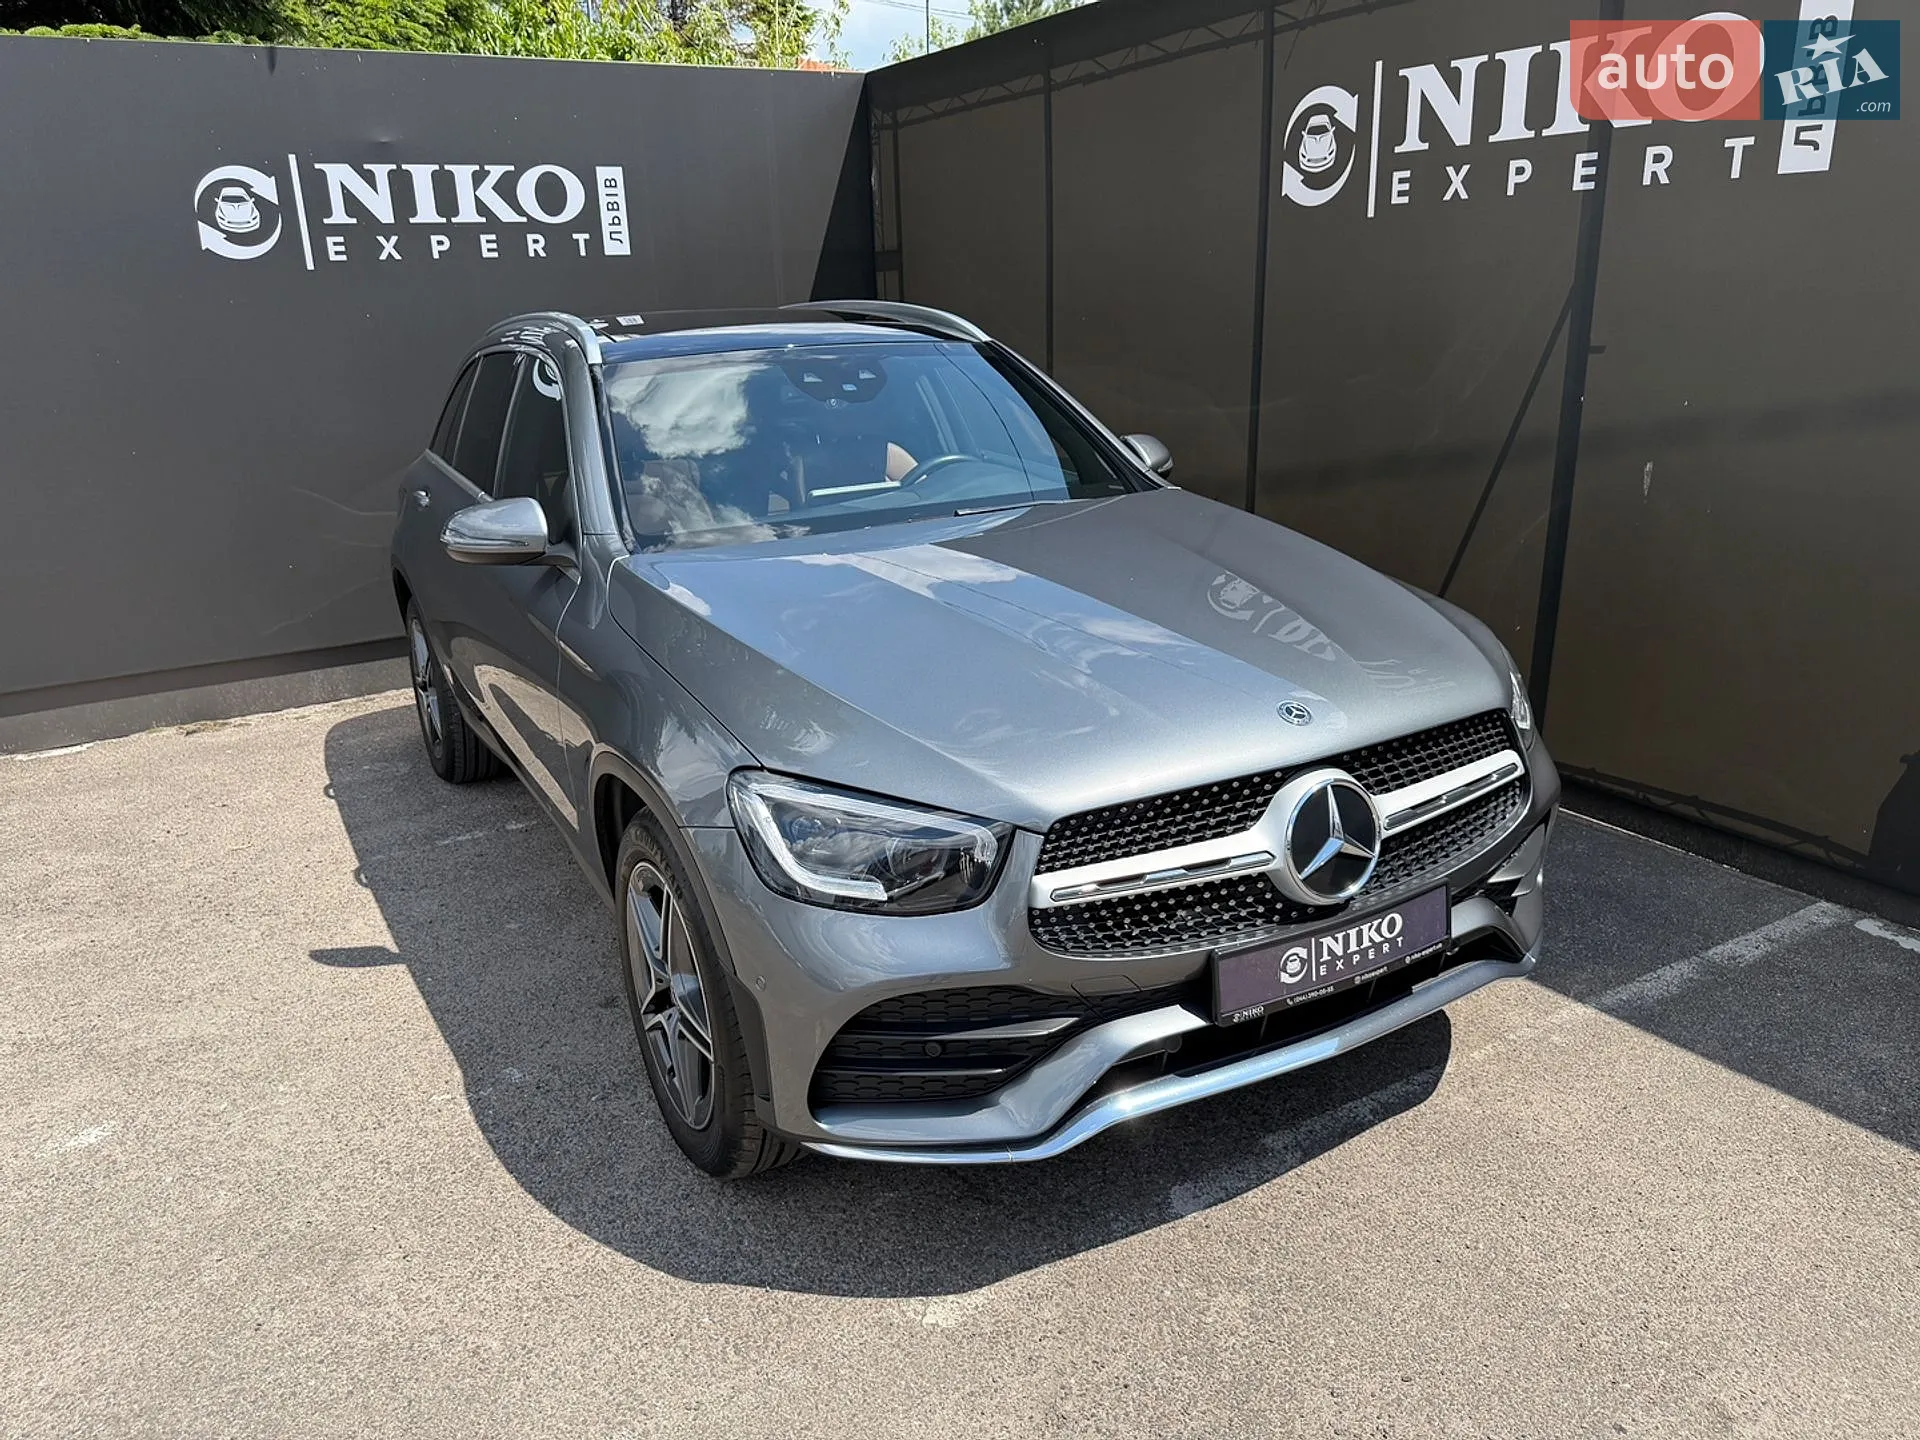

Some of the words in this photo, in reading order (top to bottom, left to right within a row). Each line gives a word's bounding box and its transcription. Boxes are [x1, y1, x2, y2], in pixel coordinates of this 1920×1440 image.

[1394, 12, 1765, 154] NIKO
[313, 162, 586, 225] NIKO
[1391, 136, 1756, 205] EXPERT
[604, 177, 624, 245] ЛЬВІВ
[325, 232, 591, 262] EXPERT
[1319, 912, 1404, 963] NIKO
[1319, 936, 1404, 977] EXPERT
